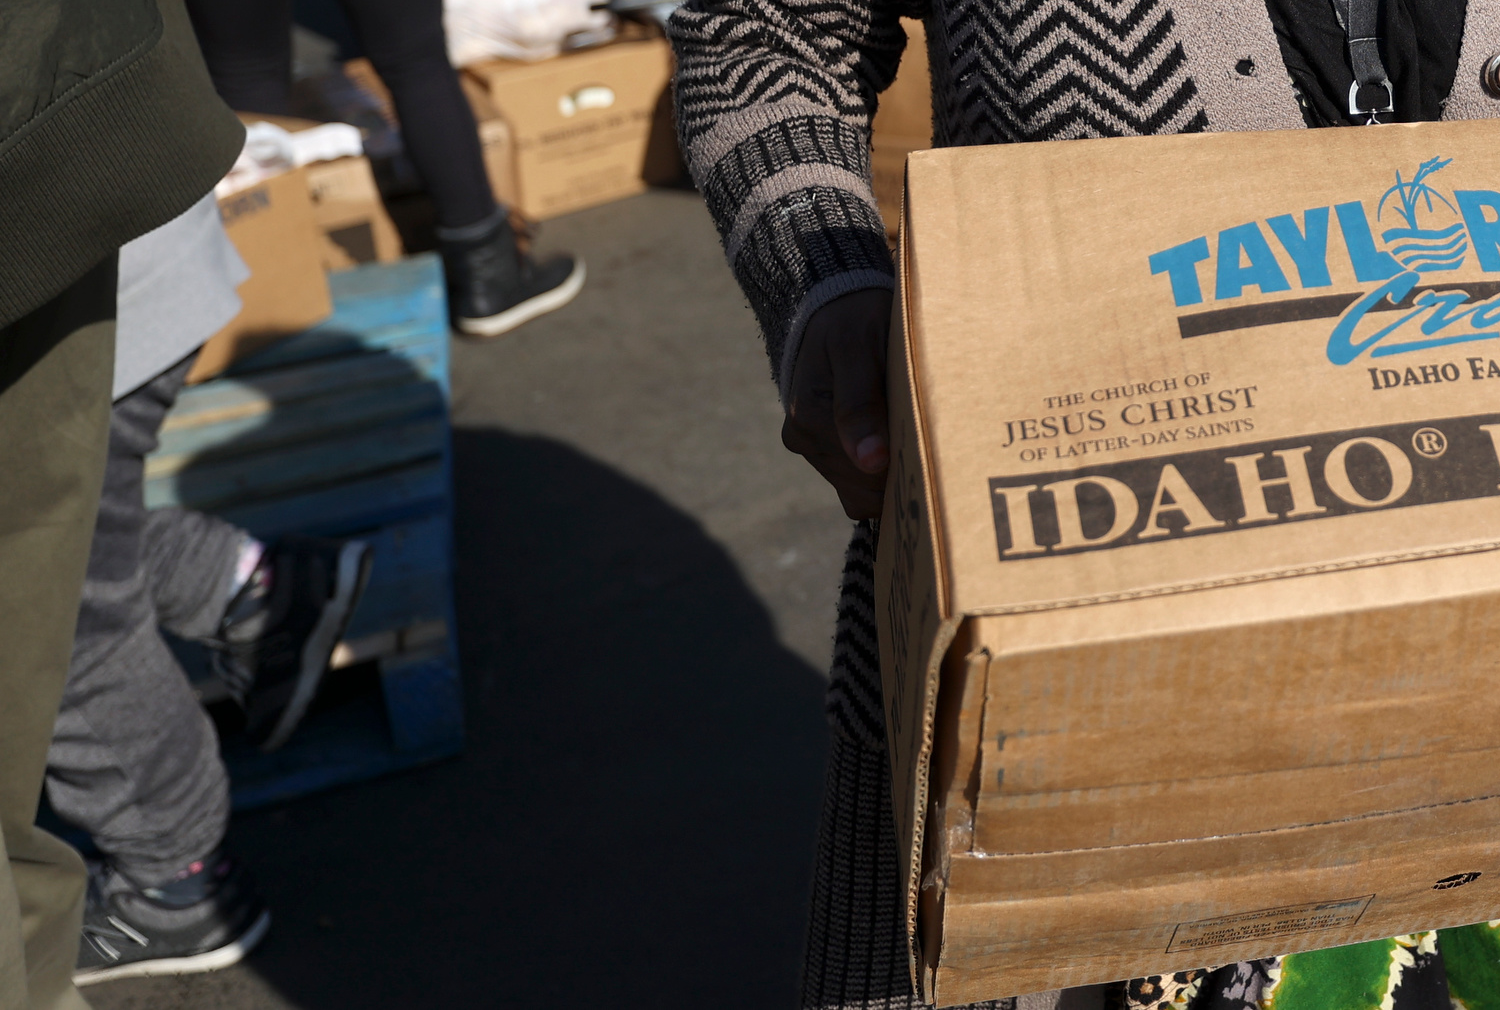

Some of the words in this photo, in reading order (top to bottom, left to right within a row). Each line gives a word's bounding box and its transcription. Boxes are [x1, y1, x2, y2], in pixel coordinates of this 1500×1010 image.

[1043, 391, 1085, 409] THE
[1090, 377, 1178, 402] CHURCH
[1184, 371, 1212, 389] OF
[1368, 362, 1460, 390] IDAHO
[1002, 408, 1107, 448] JESUS
[1121, 384, 1259, 426] CHRIST
[1019, 447, 1048, 463] OF
[1055, 427, 1181, 459] LATTER-DAY
[1186, 417, 1255, 440] SAINTS
